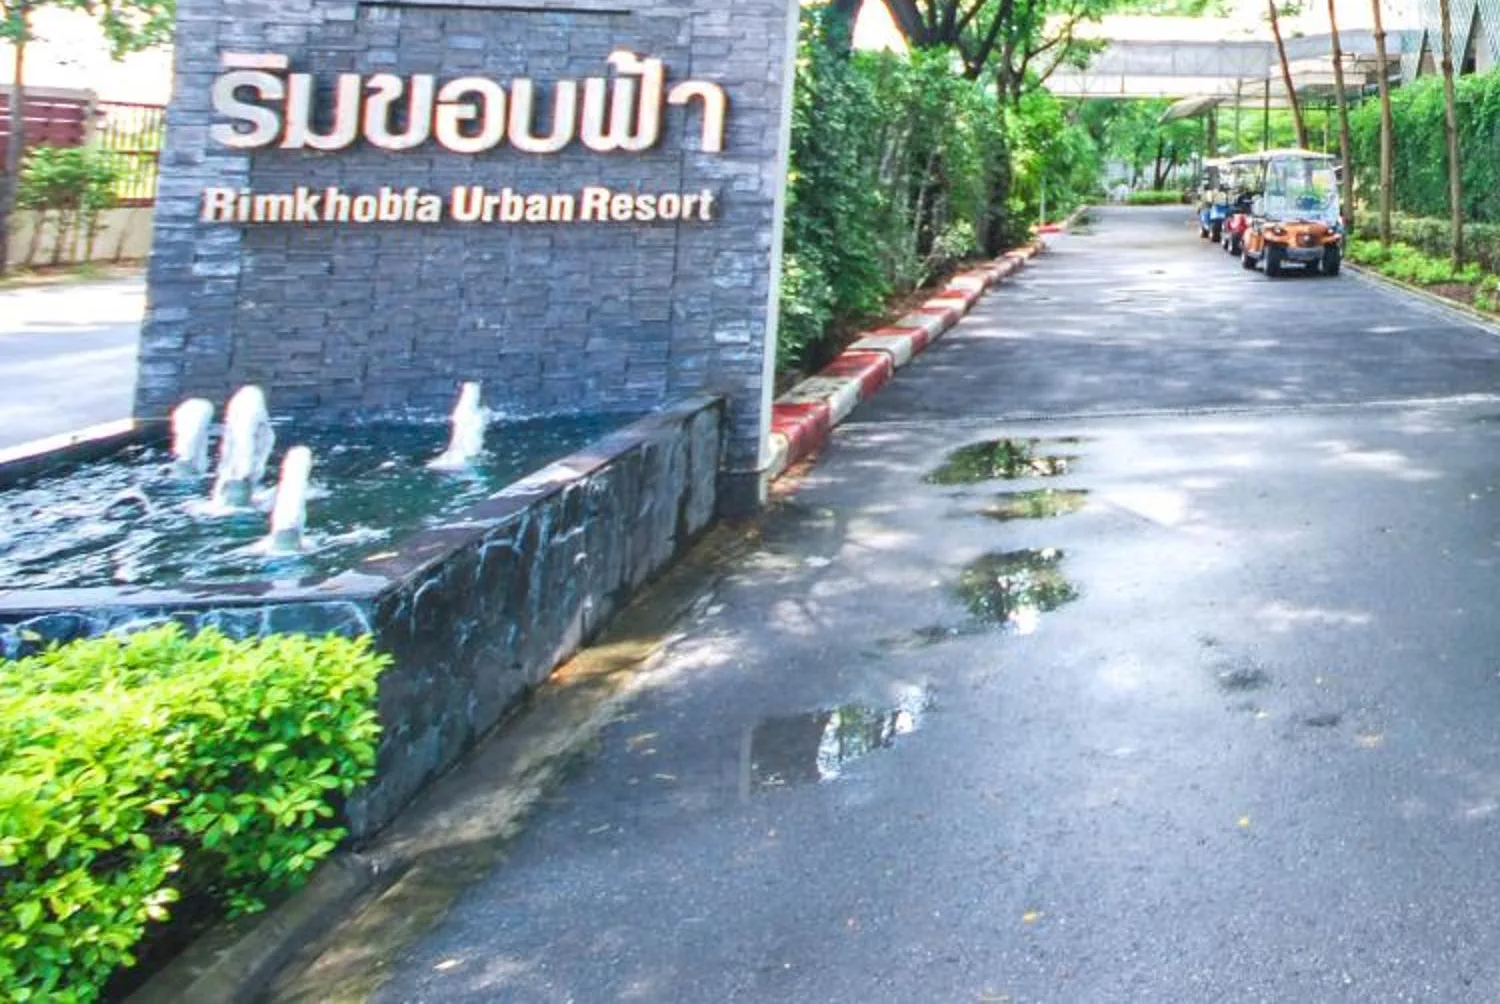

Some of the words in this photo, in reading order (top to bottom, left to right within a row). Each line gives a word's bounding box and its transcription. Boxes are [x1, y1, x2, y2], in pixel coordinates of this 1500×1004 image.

[211, 49, 727, 152] ริมขอบฟ้า
[203, 186, 440, 223] Rimkhobfa
[452, 186, 573, 222] Urban
[582, 185, 714, 221] Resort
